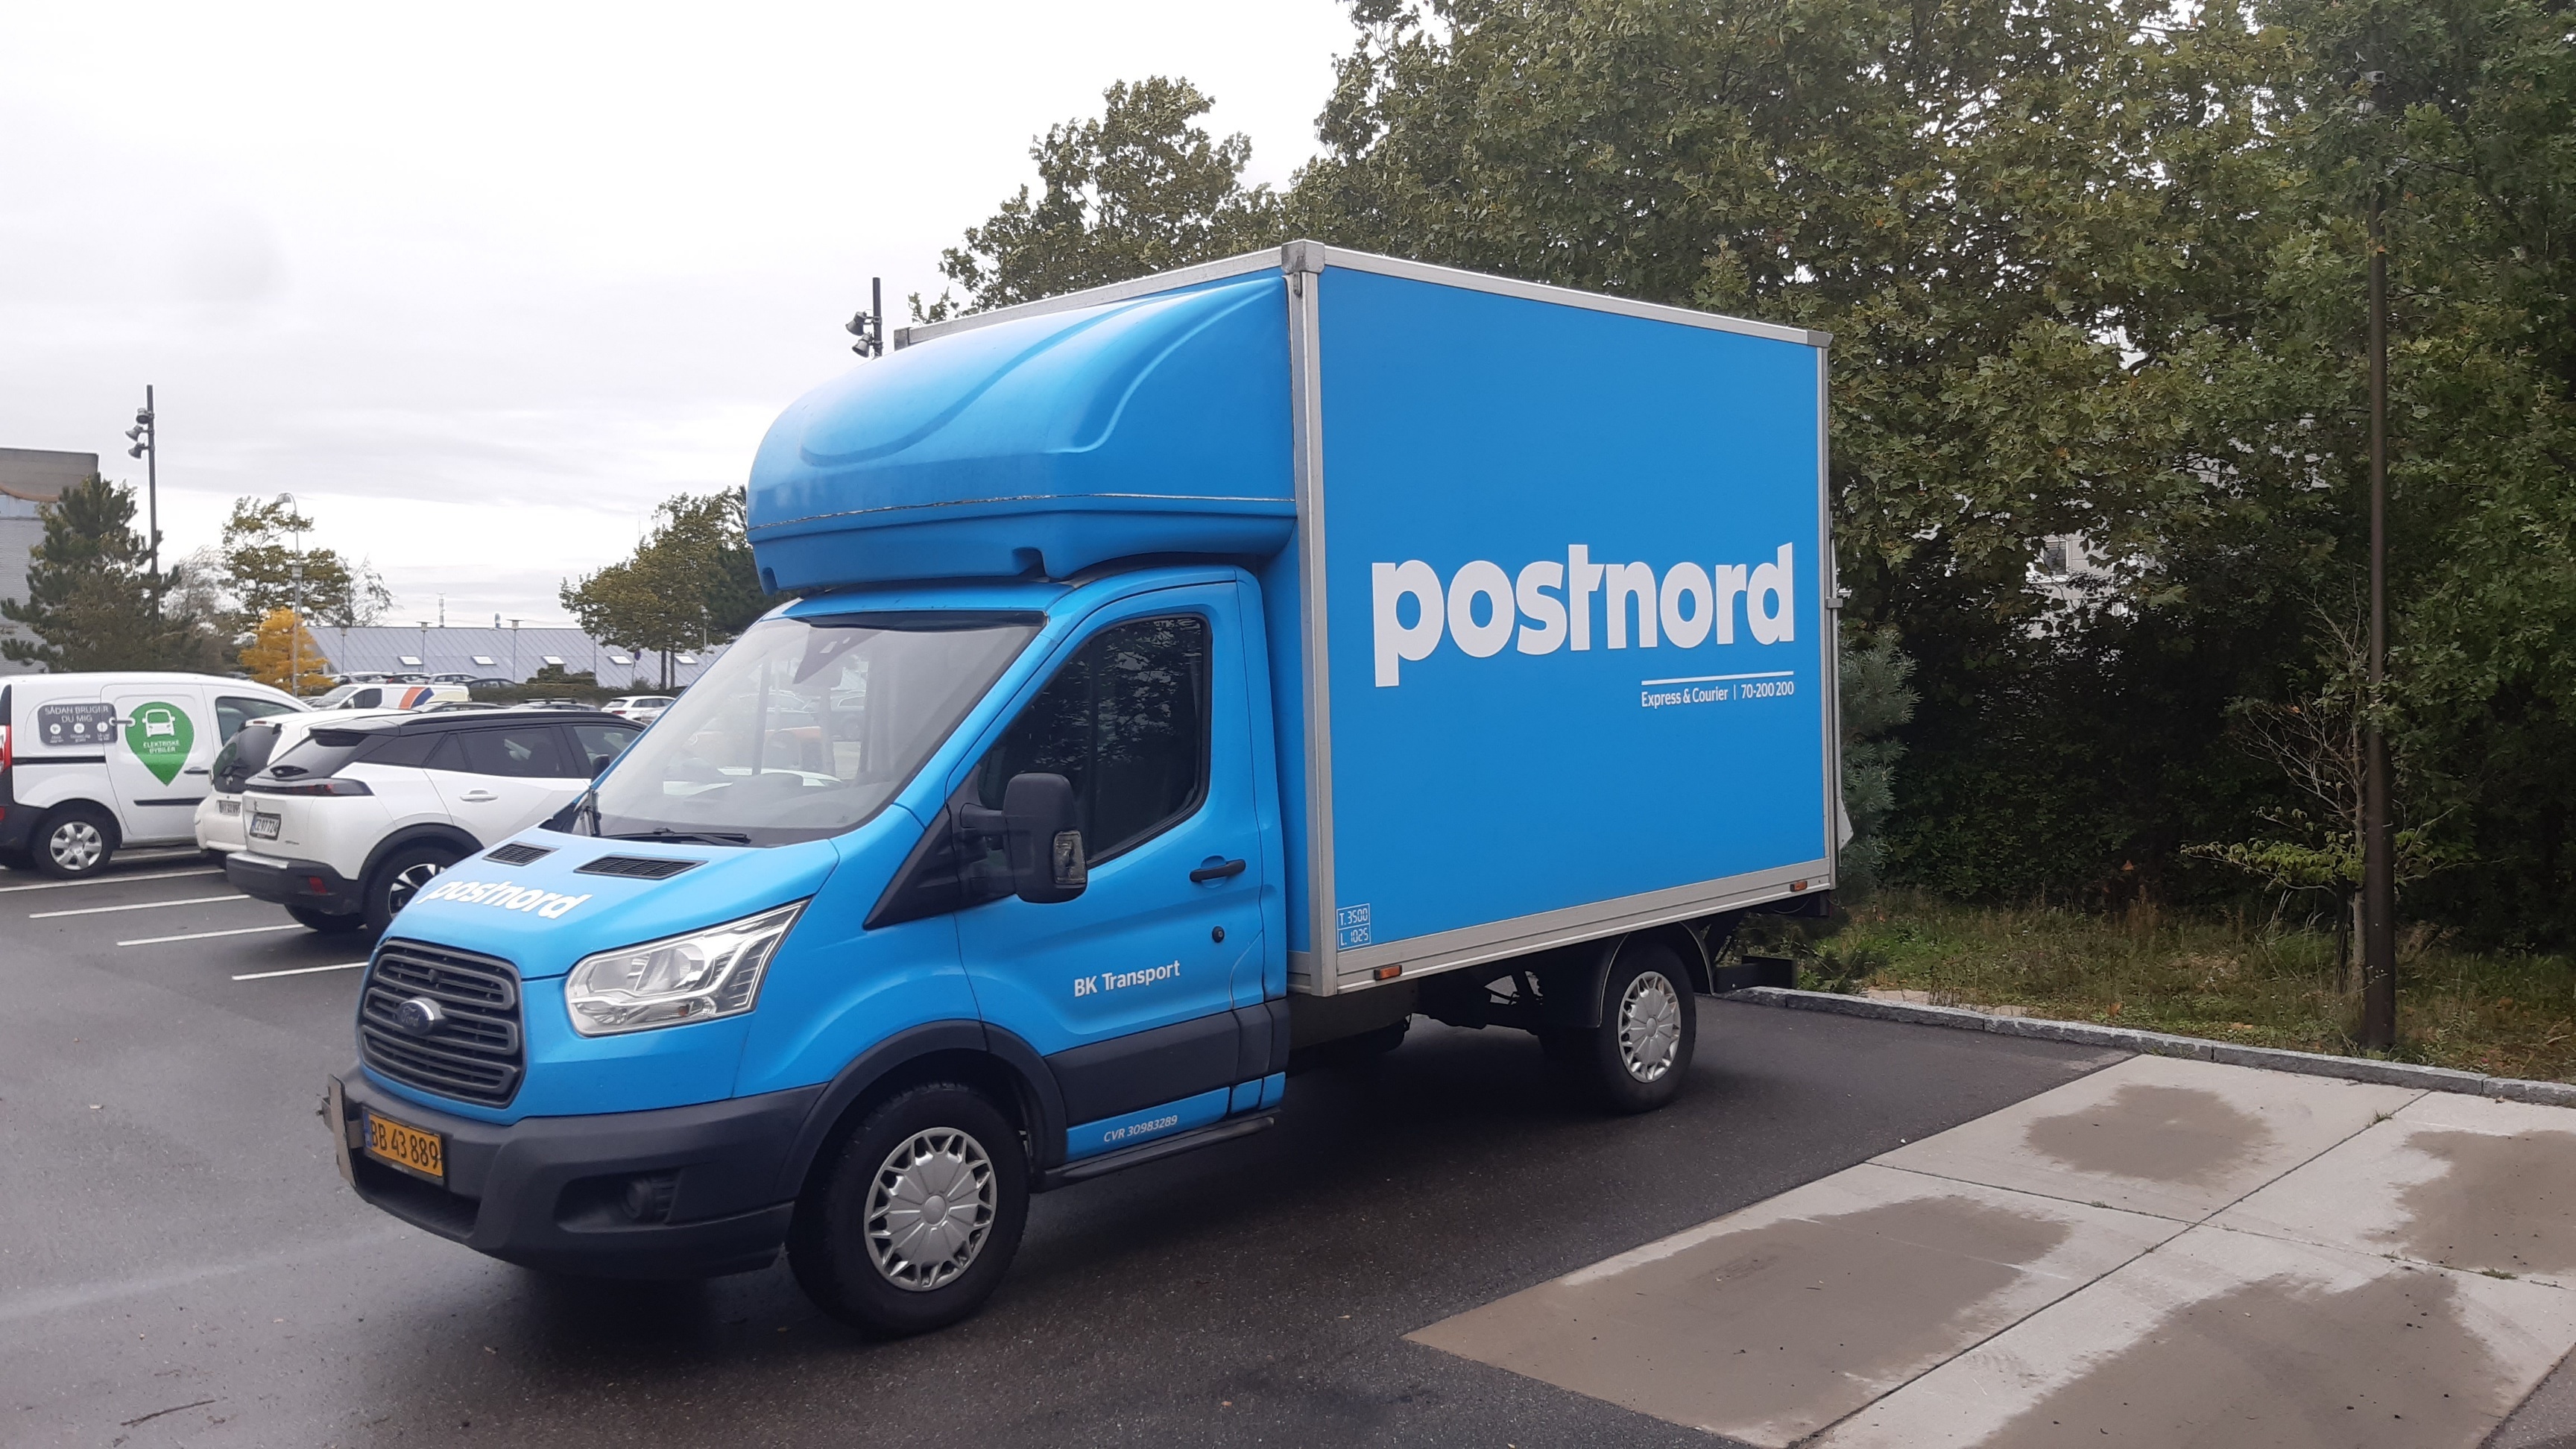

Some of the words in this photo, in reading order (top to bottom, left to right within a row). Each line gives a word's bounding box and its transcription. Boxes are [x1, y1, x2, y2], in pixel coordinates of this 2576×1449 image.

[1371, 542, 1794, 686] postnord
[1641, 692, 1682, 709] Express
[1682, 688, 1691, 704] &
[1692, 686, 1729, 703] Courier
[1740, 683, 1775, 698] 70-200
[1775, 681, 1794, 696] 200
[415, 881, 593, 919] postnord
[1348, 908, 1368, 924] 3500
[1351, 927, 1368, 943] 1025
[1074, 975, 1098, 997] BK
[1102, 959, 1181, 991] Transport
[402, 1006, 420, 1026] Ford
[1104, 1128, 1126, 1142] CVR
[1126, 1114, 1178, 1137] 30983289
[370, 1120, 388, 1151] BB
[391, 1128, 407, 1158] 43
[410, 1134, 439, 1169] 889
